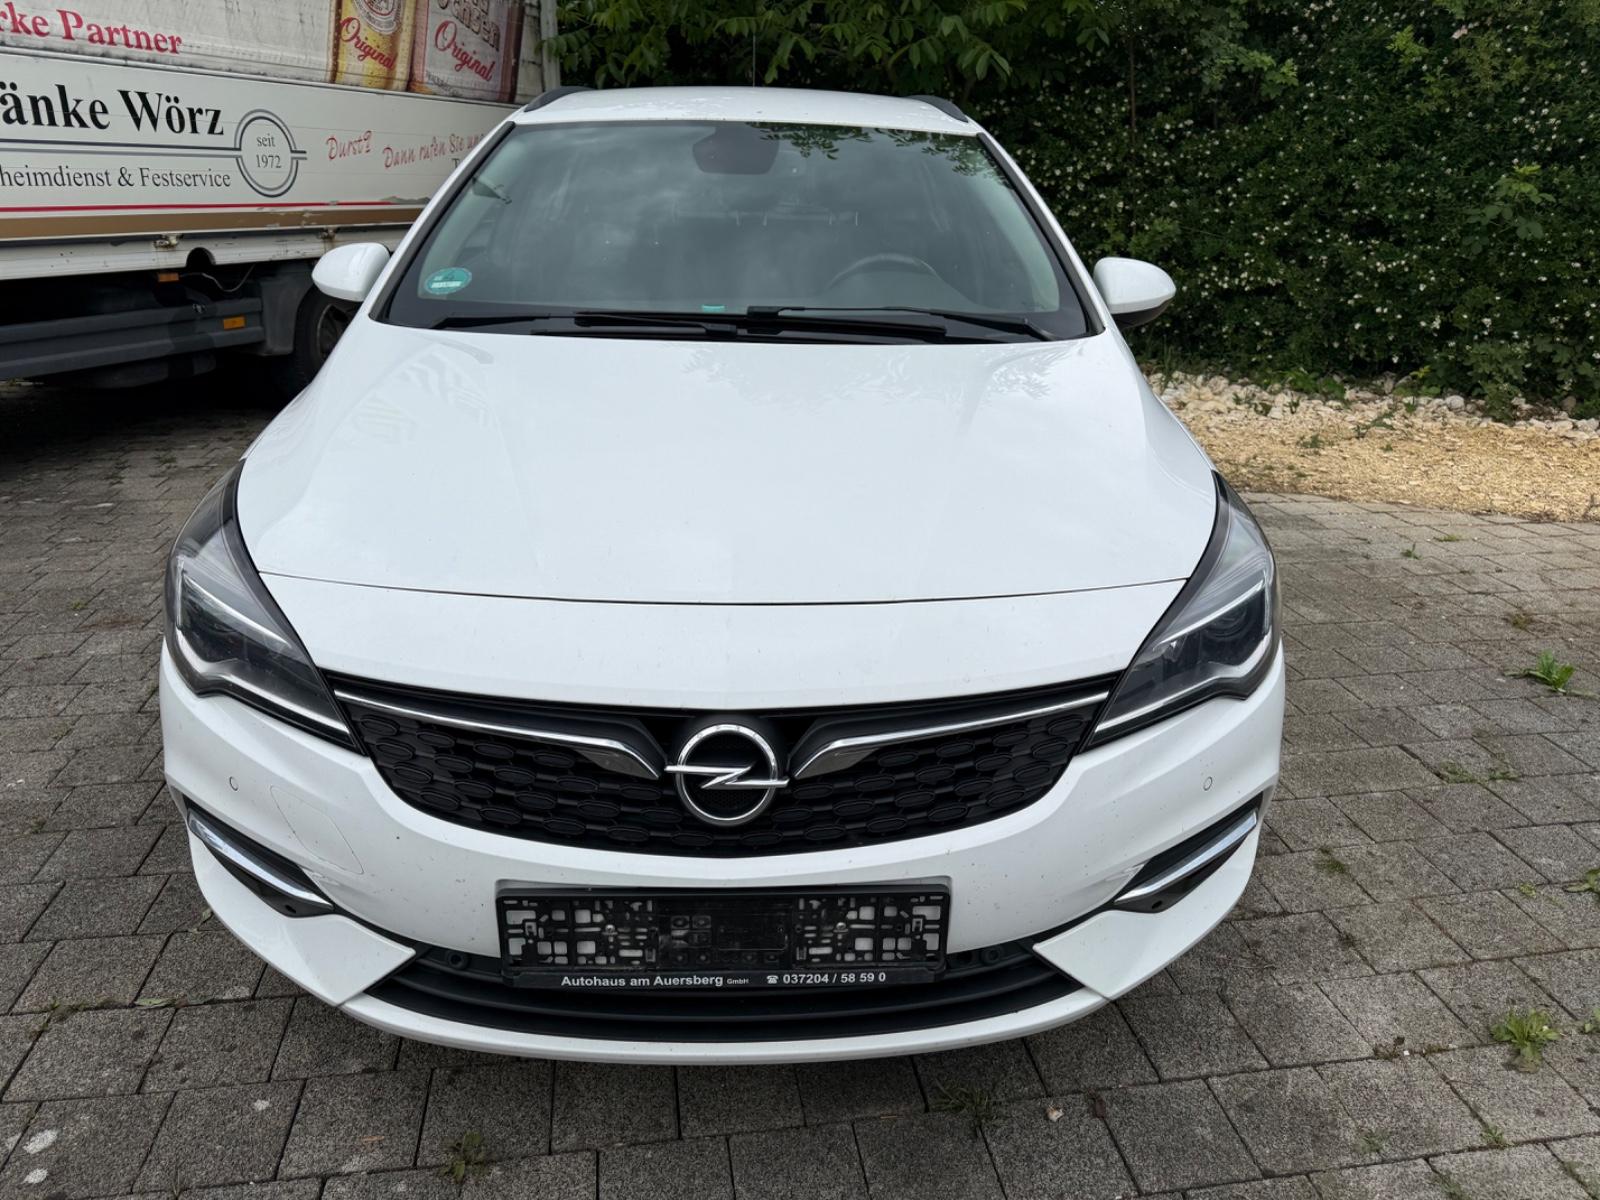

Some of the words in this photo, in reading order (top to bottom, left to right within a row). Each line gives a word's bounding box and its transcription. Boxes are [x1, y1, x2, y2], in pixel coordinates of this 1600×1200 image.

[56, 9, 183, 54] Partner
[339, 16, 396, 71] Original
[435, 20, 496, 81] Original
[117, 89, 224, 135] Wörz
[256, 135, 276, 148] seit
[326, 130, 372, 160] Durst?
[382, 146, 415, 168] Dann
[419, 136, 446, 160] rufen
[449, 133, 464, 153] Sie
[117, 167, 135, 188] &
[139, 167, 231, 188] Festservice
[255, 154, 282, 169] 1972
[561, 976, 626, 986] Autohaus
[630, 977, 650, 987] am
[653, 975, 723, 987] Auersberg
[783, 974, 829, 984] 037204
[841, 973, 856, 983] 58
[859, 972, 875, 983] 59
[878, 972, 886, 982] 0
